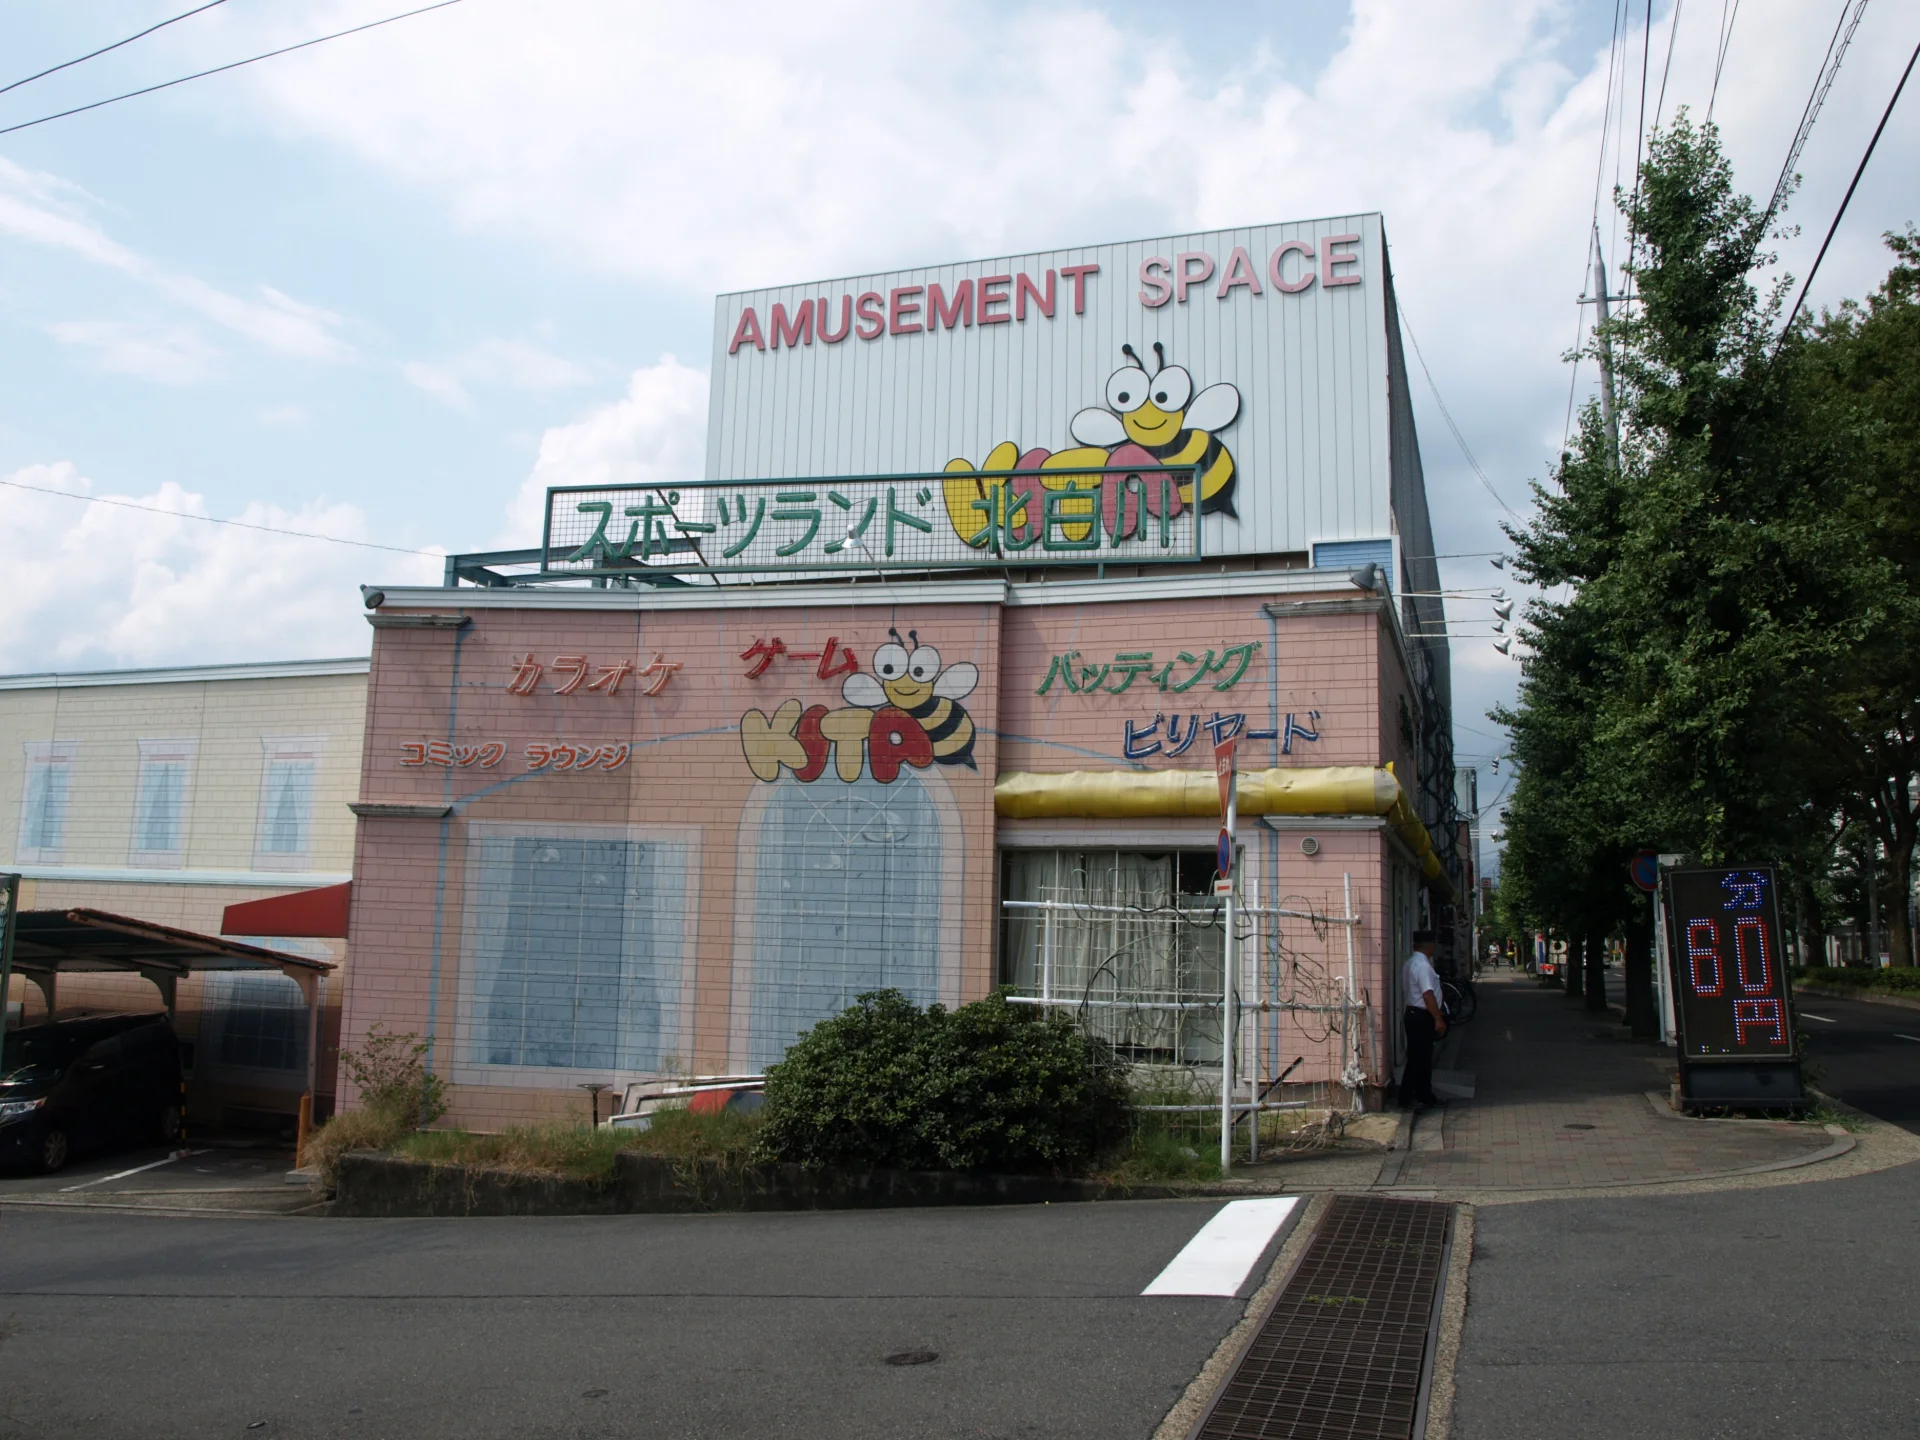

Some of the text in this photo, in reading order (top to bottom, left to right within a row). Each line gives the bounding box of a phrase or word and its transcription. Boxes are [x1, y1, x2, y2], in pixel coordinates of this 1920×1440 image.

[728, 232, 1362, 355] AMUSEMENT SPACE
[505, 653, 685, 697] カラオケ
[739, 636, 859, 681] ゲーム
[1034, 639, 1263, 696] バッティング
[400, 740, 632, 771] コミック ラウンジ
[1123, 710, 1321, 760] ビリヤード
